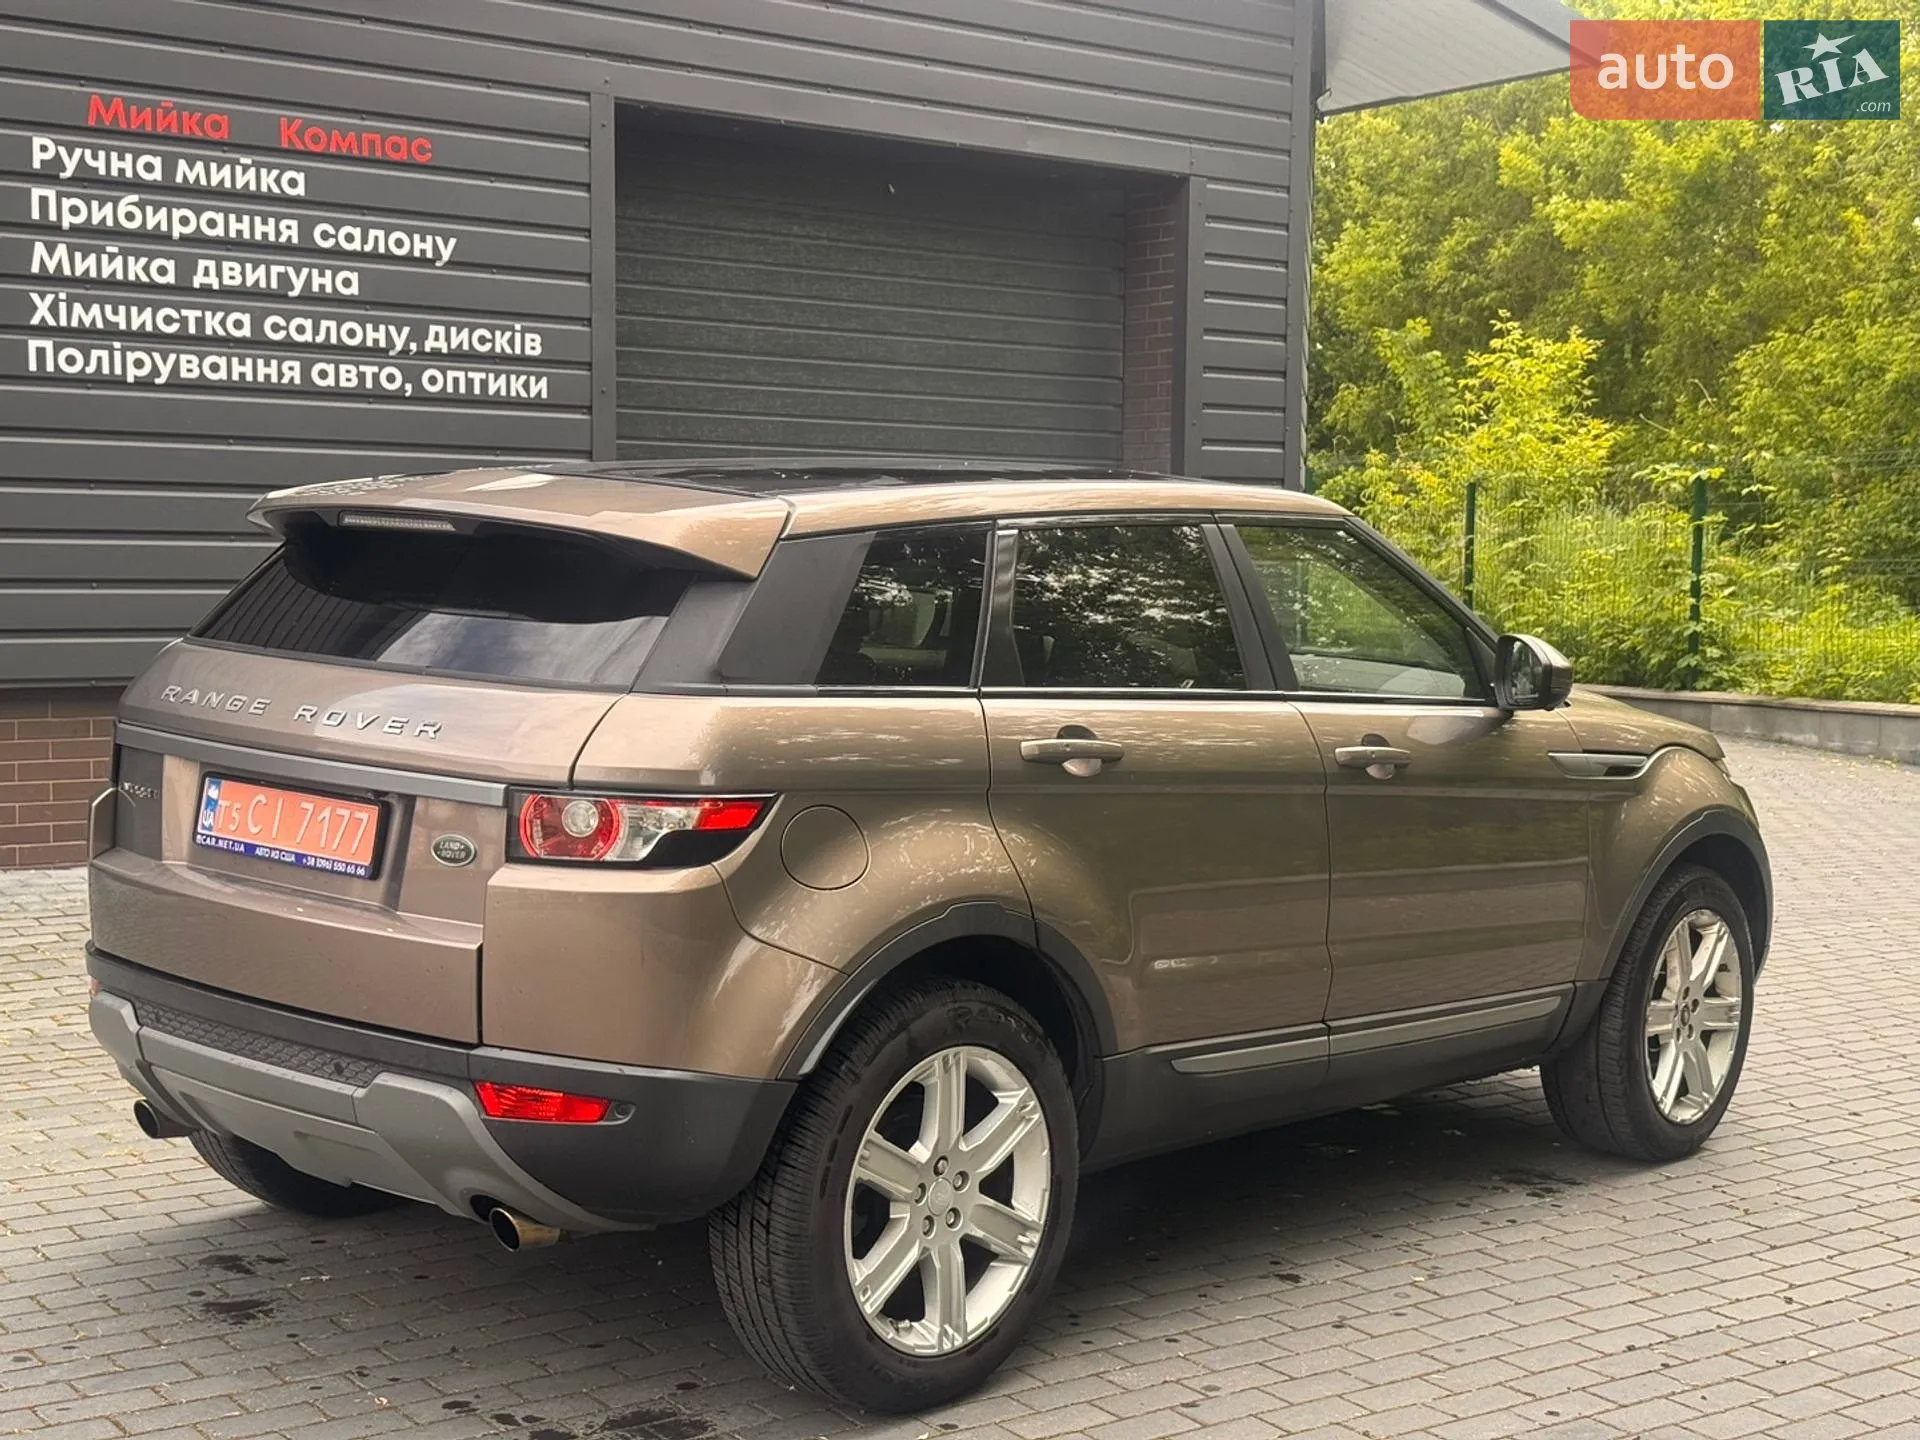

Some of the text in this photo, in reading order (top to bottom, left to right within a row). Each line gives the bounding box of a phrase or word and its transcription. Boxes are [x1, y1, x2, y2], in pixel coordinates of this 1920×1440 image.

[87, 94, 433, 164] Мийка Компас
[32, 136, 306, 197] Ручна мийка
[30, 188, 457, 267] Прибирання салону
[30, 241, 359, 297] Мийка двигуна
[29, 292, 543, 357] Хімчистка салону, дисків
[28, 339, 548, 399] Полірування авто, оптики
[160, 685, 445, 740] RANGE ROVER
[296, 802, 370, 855] 7177
